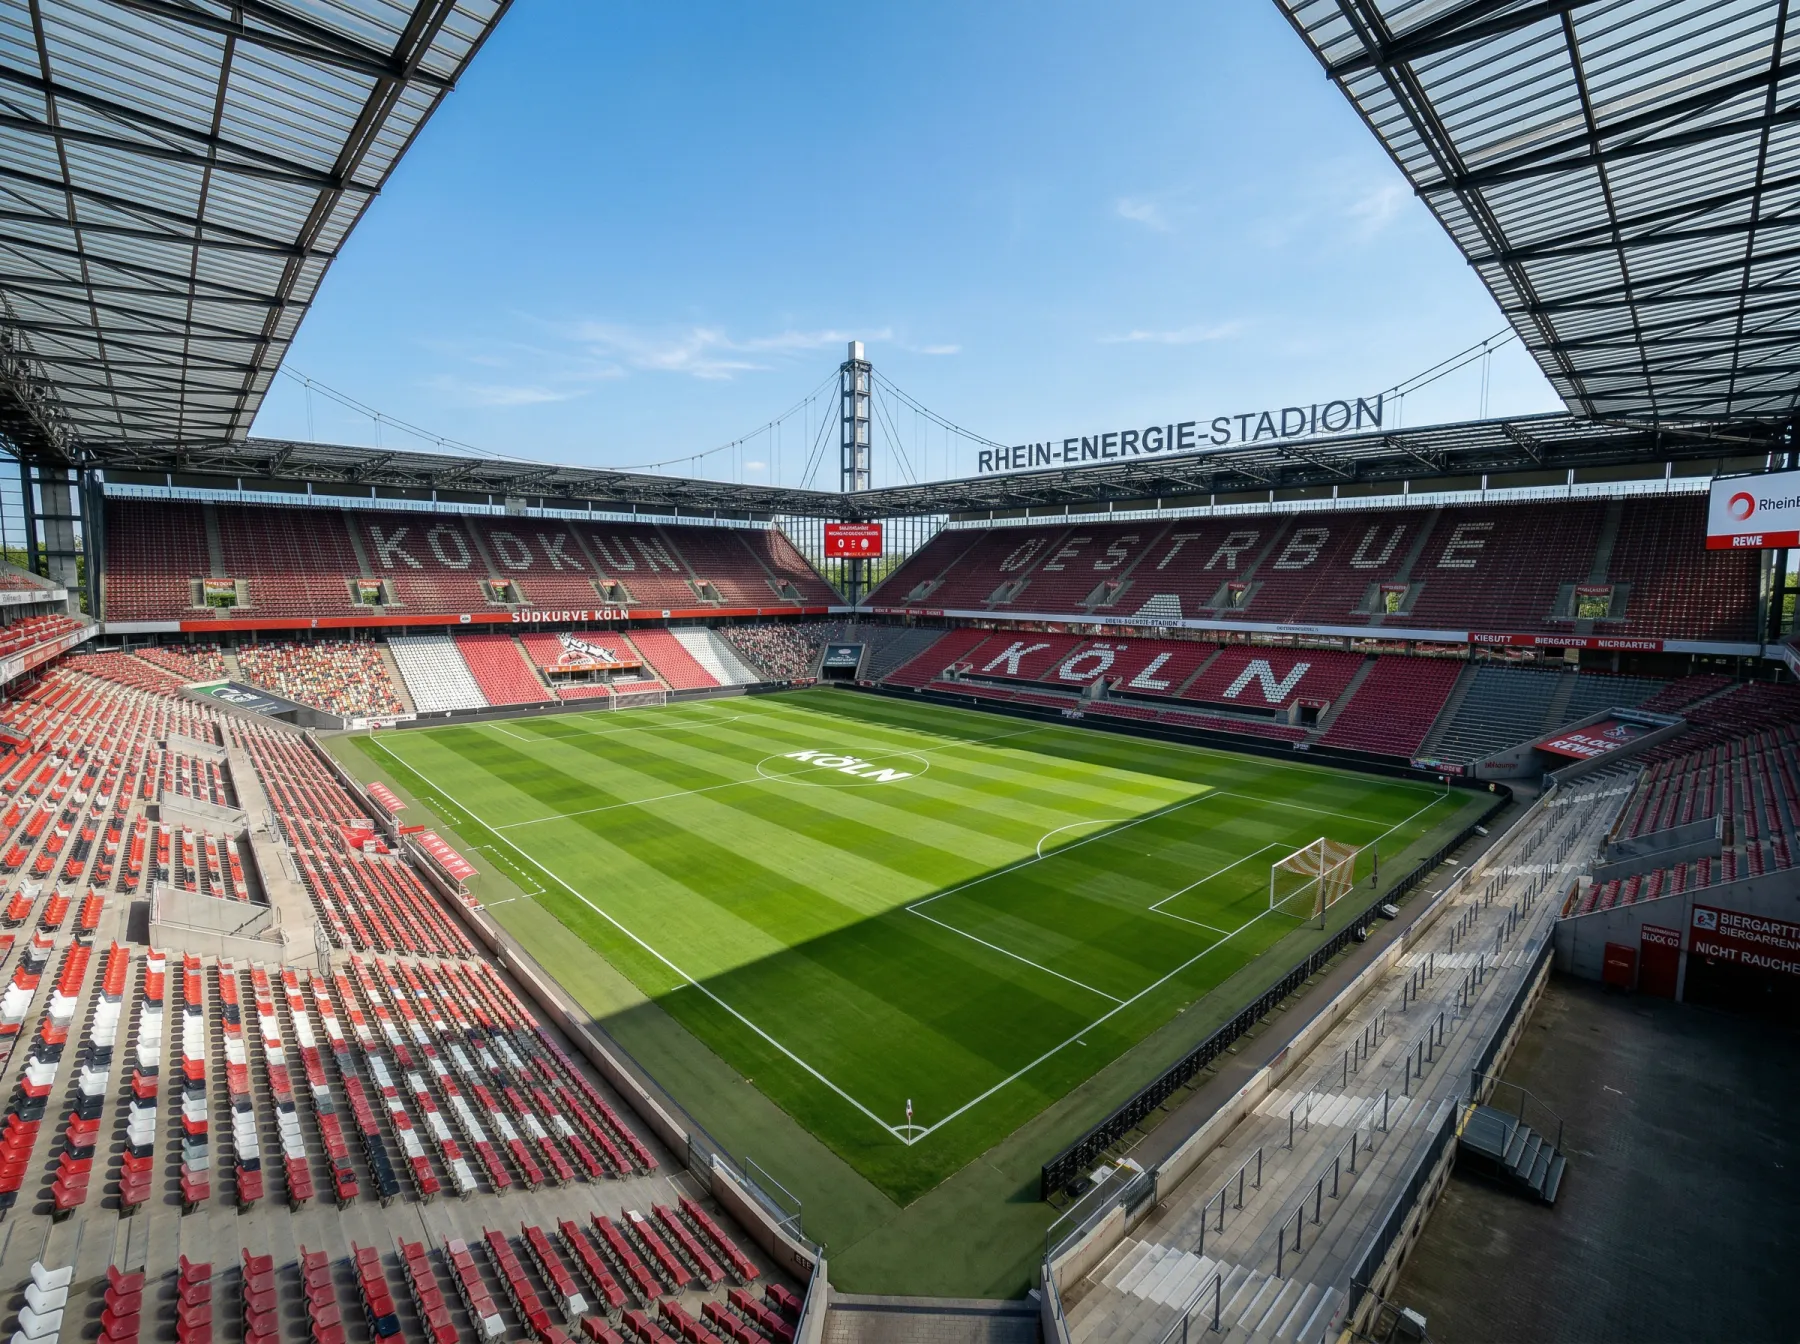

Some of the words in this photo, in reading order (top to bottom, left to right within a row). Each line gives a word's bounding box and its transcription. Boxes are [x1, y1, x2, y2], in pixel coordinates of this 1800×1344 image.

[979, 394, 1383, 473] RHEIN-ENERGIE-STADION
[1732, 535, 1763, 547] REWE
[511, 608, 589, 623] SÜDKURVE
[594, 606, 629, 621] KÖLN
[1535, 636, 1588, 647] BIERGARTEN
[982, 643, 1311, 703] KÖLN
[784, 749, 914, 782] KÖLN
[1720, 912, 1800, 939] BIERGARTT
[1695, 941, 1738, 960] NICHT
